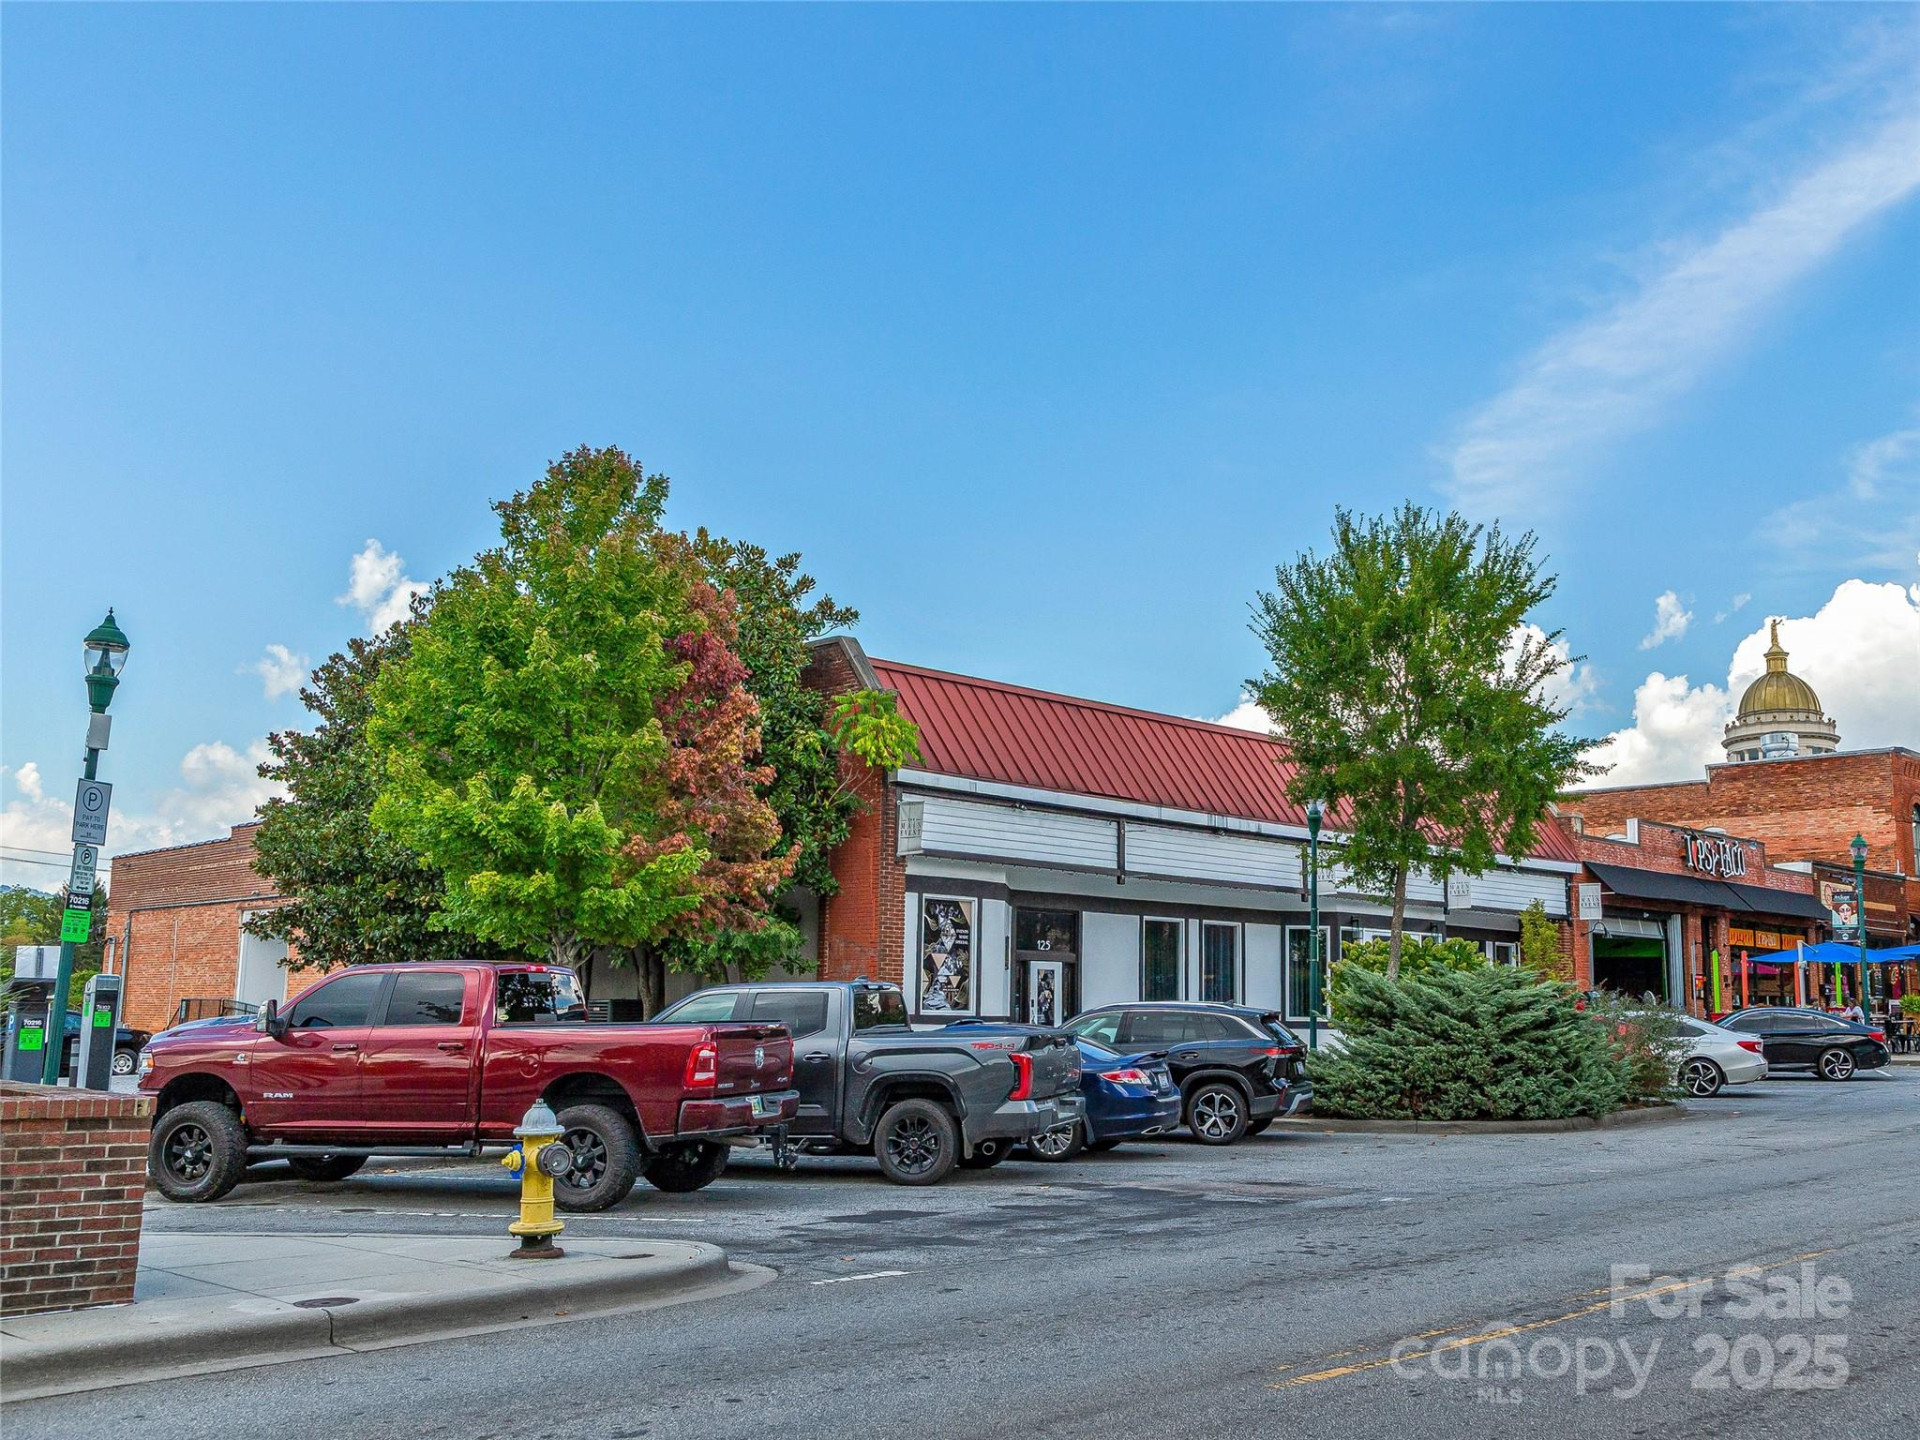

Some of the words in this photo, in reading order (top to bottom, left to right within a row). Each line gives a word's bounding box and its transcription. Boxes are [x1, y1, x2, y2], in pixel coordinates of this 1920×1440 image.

[88, 792, 98, 807] P
[76, 821, 90, 829] PARK
[1717, 839, 1746, 878] TACO
[1037, 940, 1051, 951] 125
